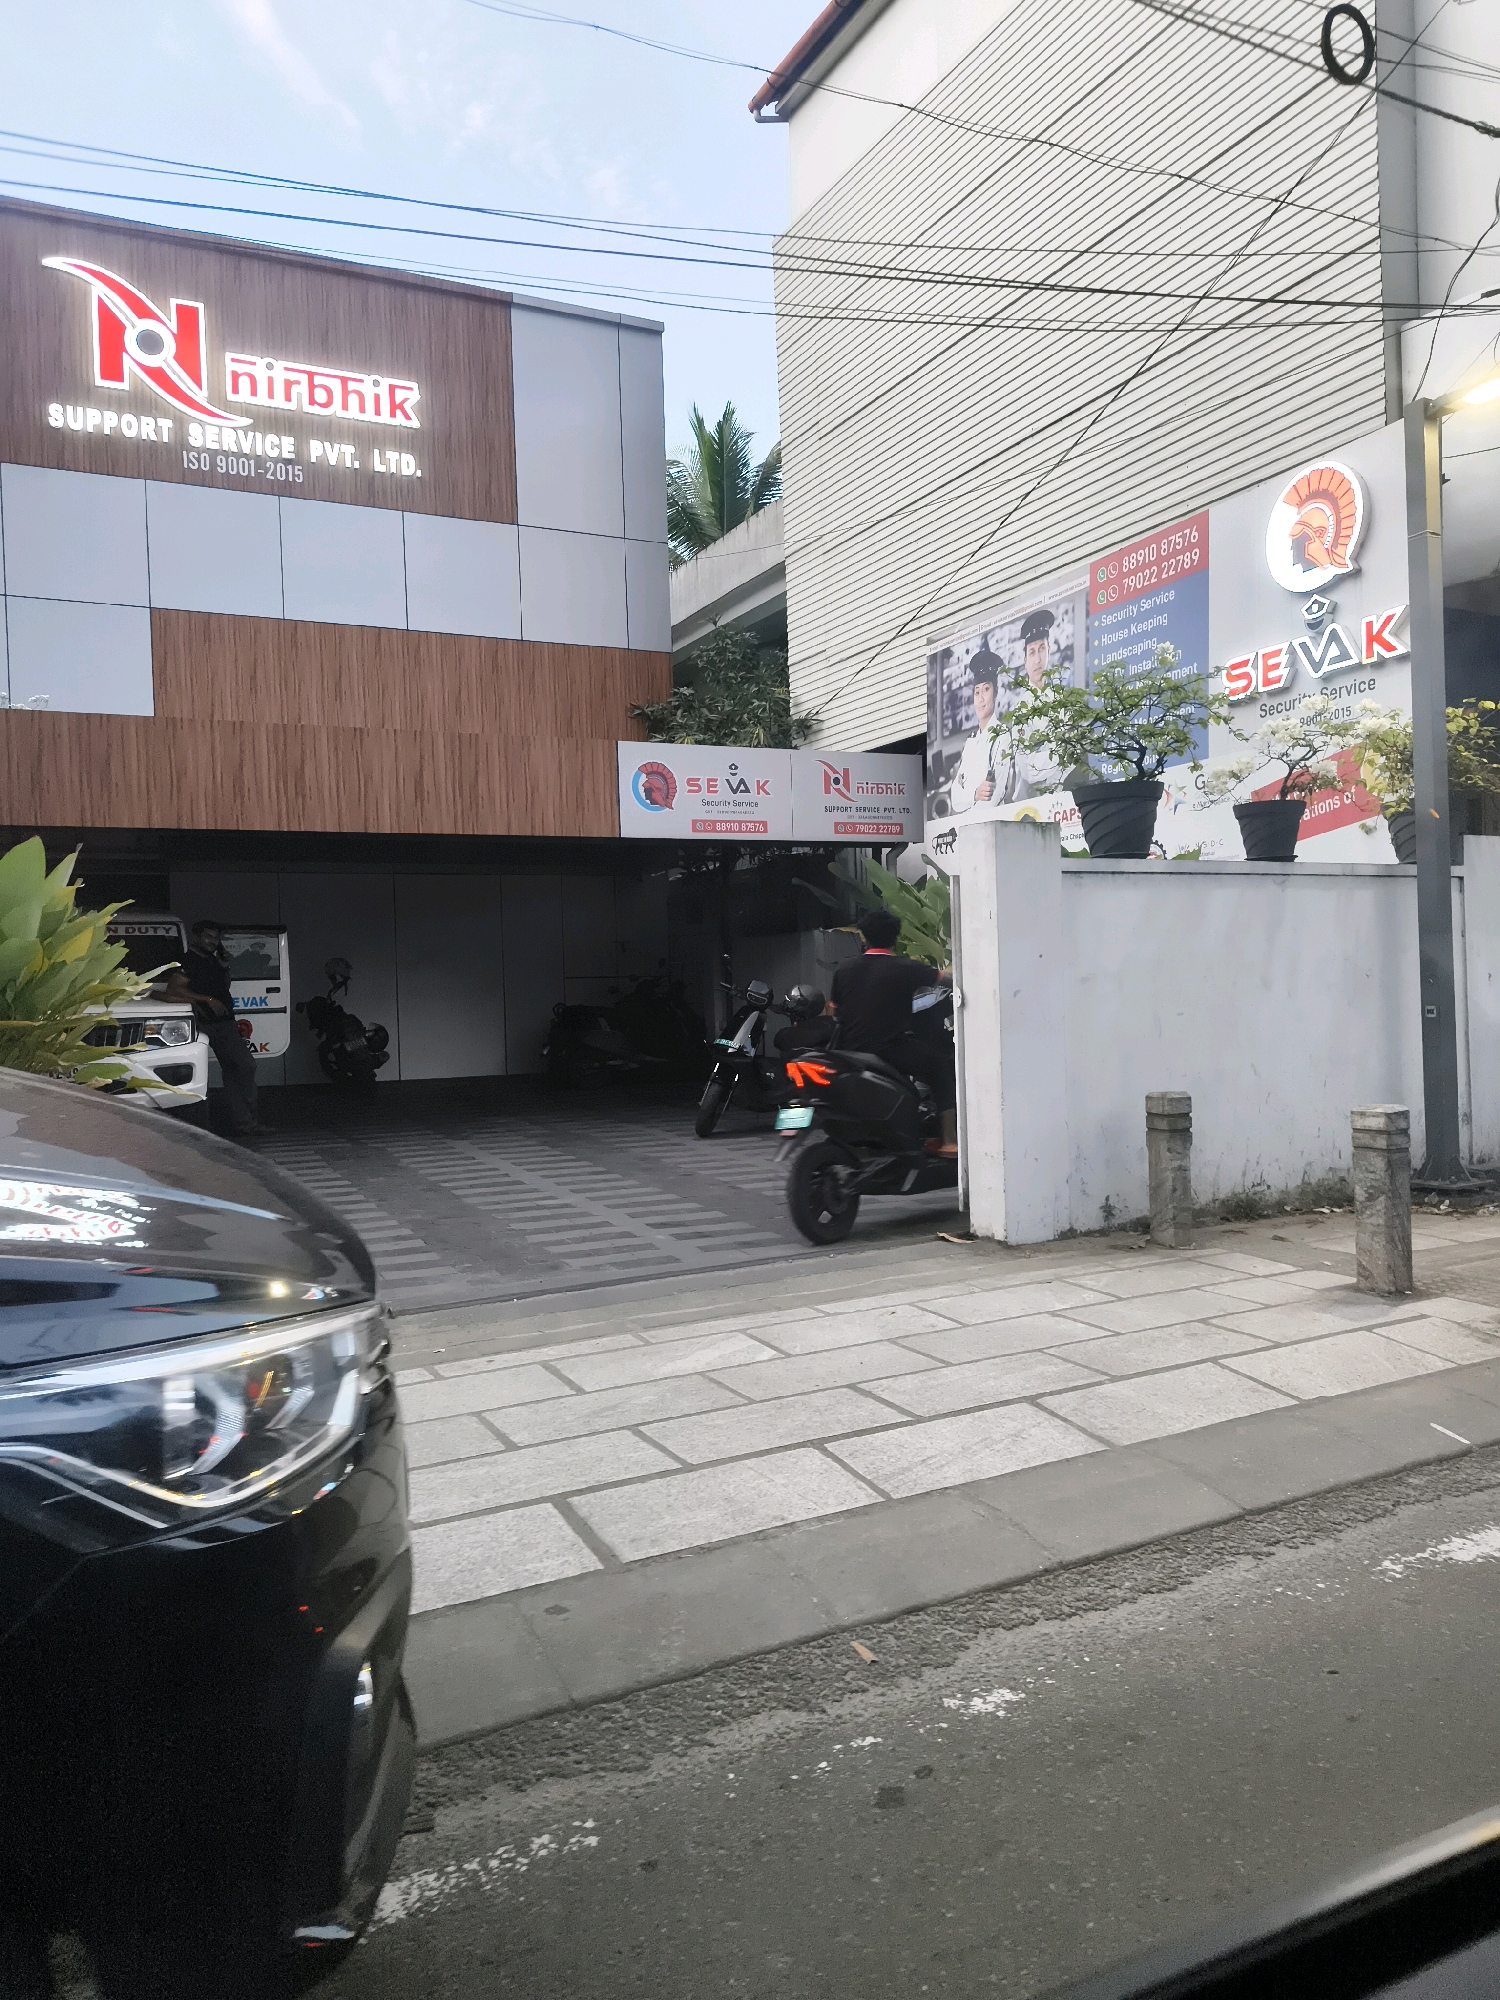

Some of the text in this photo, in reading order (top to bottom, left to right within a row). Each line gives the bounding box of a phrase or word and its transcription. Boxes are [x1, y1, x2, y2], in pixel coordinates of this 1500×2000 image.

[228, 354, 419, 426] nirbhik
[48, 402, 422, 477] SUPPORT SERVICE PVT. LTD.
[183, 451, 304, 482] ISO 9001-2015
[1122, 525, 1199, 572] 88910 87576
[1122, 548, 1200, 595] 79022 22789
[1101, 590, 1175, 626] Security Service
[1101, 613, 1168, 646] House Keeping
[1101, 637, 1157, 666] Landscaping
[1222, 605, 1409, 700] SEVAK
[1320, 677, 1376, 700] Service
[686, 777, 770, 797] SEVAK
[856, 782, 905, 796] nirbhik
[1343, 787, 1356, 806] of
[701, 799, 758, 808] Security Service
[824, 805, 852, 813] SUPPORT
[855, 806, 880, 814] SERVICE
[1299, 798, 1341, 823] ations
[716, 822, 764, 832] 88910 87576
[855, 825, 900, 834] 79022 22789
[105, 926, 173, 935] N DUTY
[231, 996, 269, 1008] EVAK
